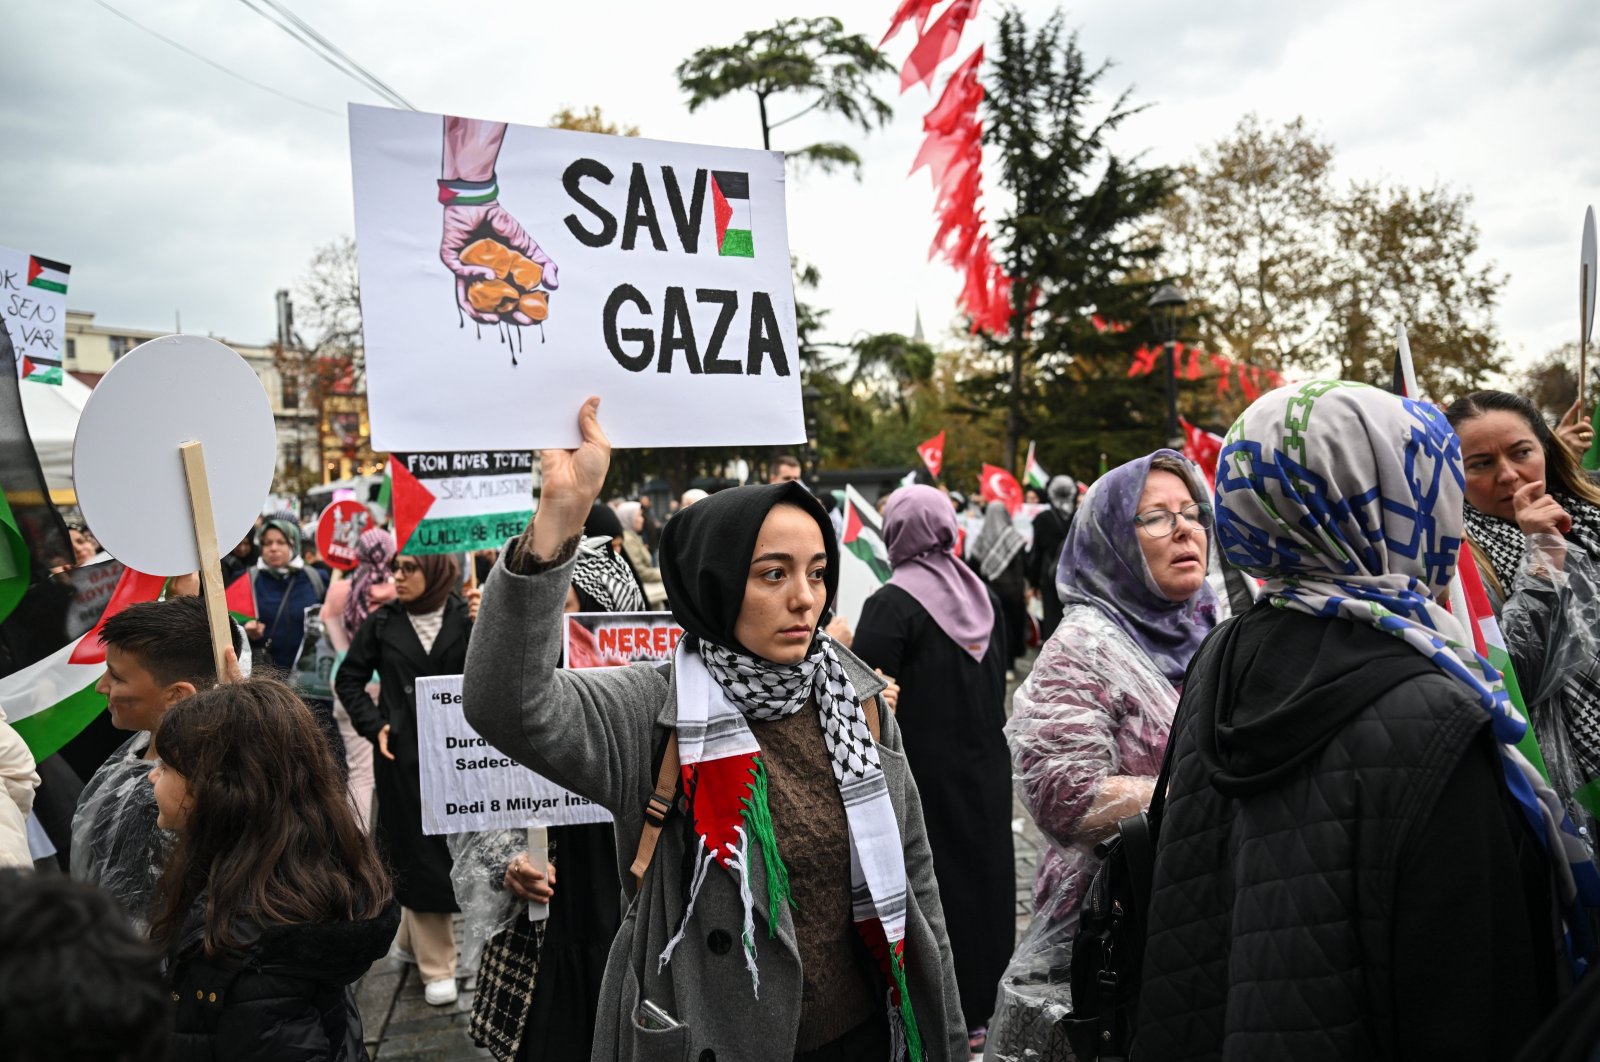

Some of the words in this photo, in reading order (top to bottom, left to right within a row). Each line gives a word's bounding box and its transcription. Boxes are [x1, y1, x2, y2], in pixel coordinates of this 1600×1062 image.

[7, 294, 56, 323] SEN
[20, 324, 58, 351] VAR
[603, 283, 790, 377] GAZA
[407, 455, 447, 472] FROM
[453, 453, 489, 470] RIVER
[419, 529, 461, 546] WILL
[471, 525, 488, 541] BE
[496, 521, 524, 540] FREE
[446, 736, 494, 749] Durd
[446, 800, 485, 815] Dedi
[490, 800, 501, 812] 8
[507, 797, 560, 812] Milyar
[565, 792, 597, 806] İns
